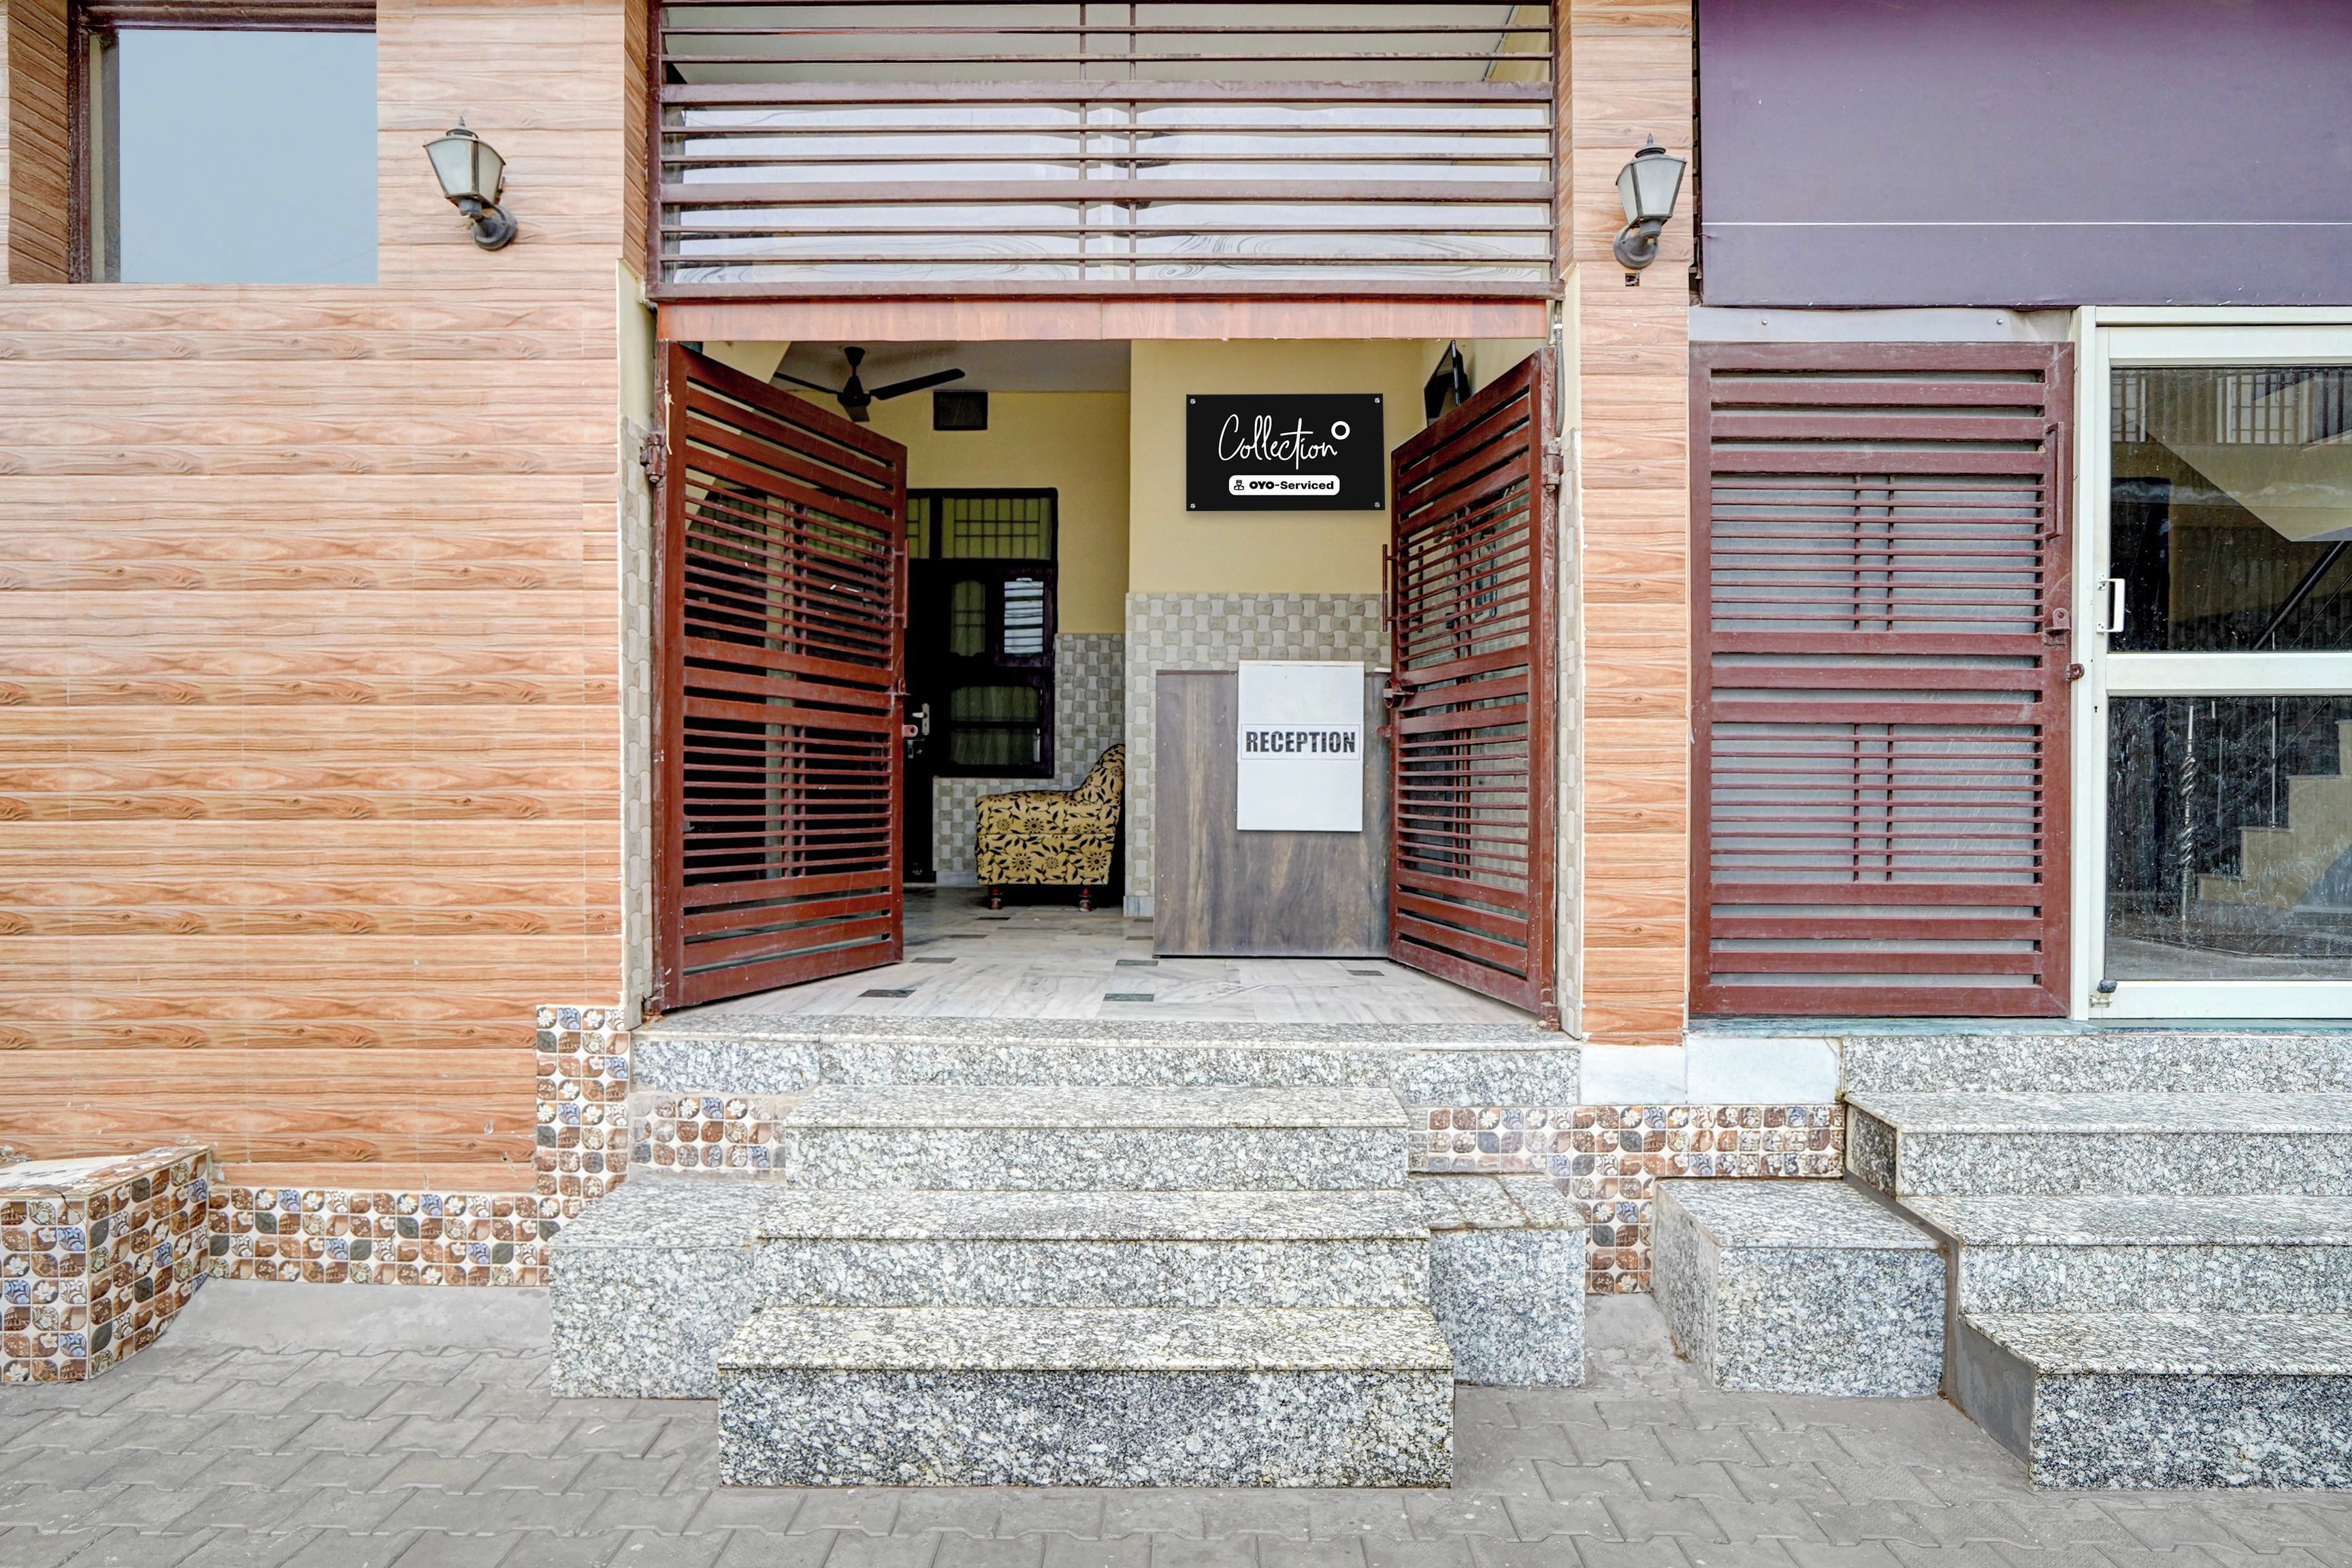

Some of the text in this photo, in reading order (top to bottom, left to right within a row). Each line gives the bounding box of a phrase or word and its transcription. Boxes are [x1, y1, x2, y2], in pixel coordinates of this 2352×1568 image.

[1218, 414, 1338, 470] Collection
[1249, 480, 1334, 490] OYO-Serviced
[1246, 731, 1356, 753] RECEPTION
